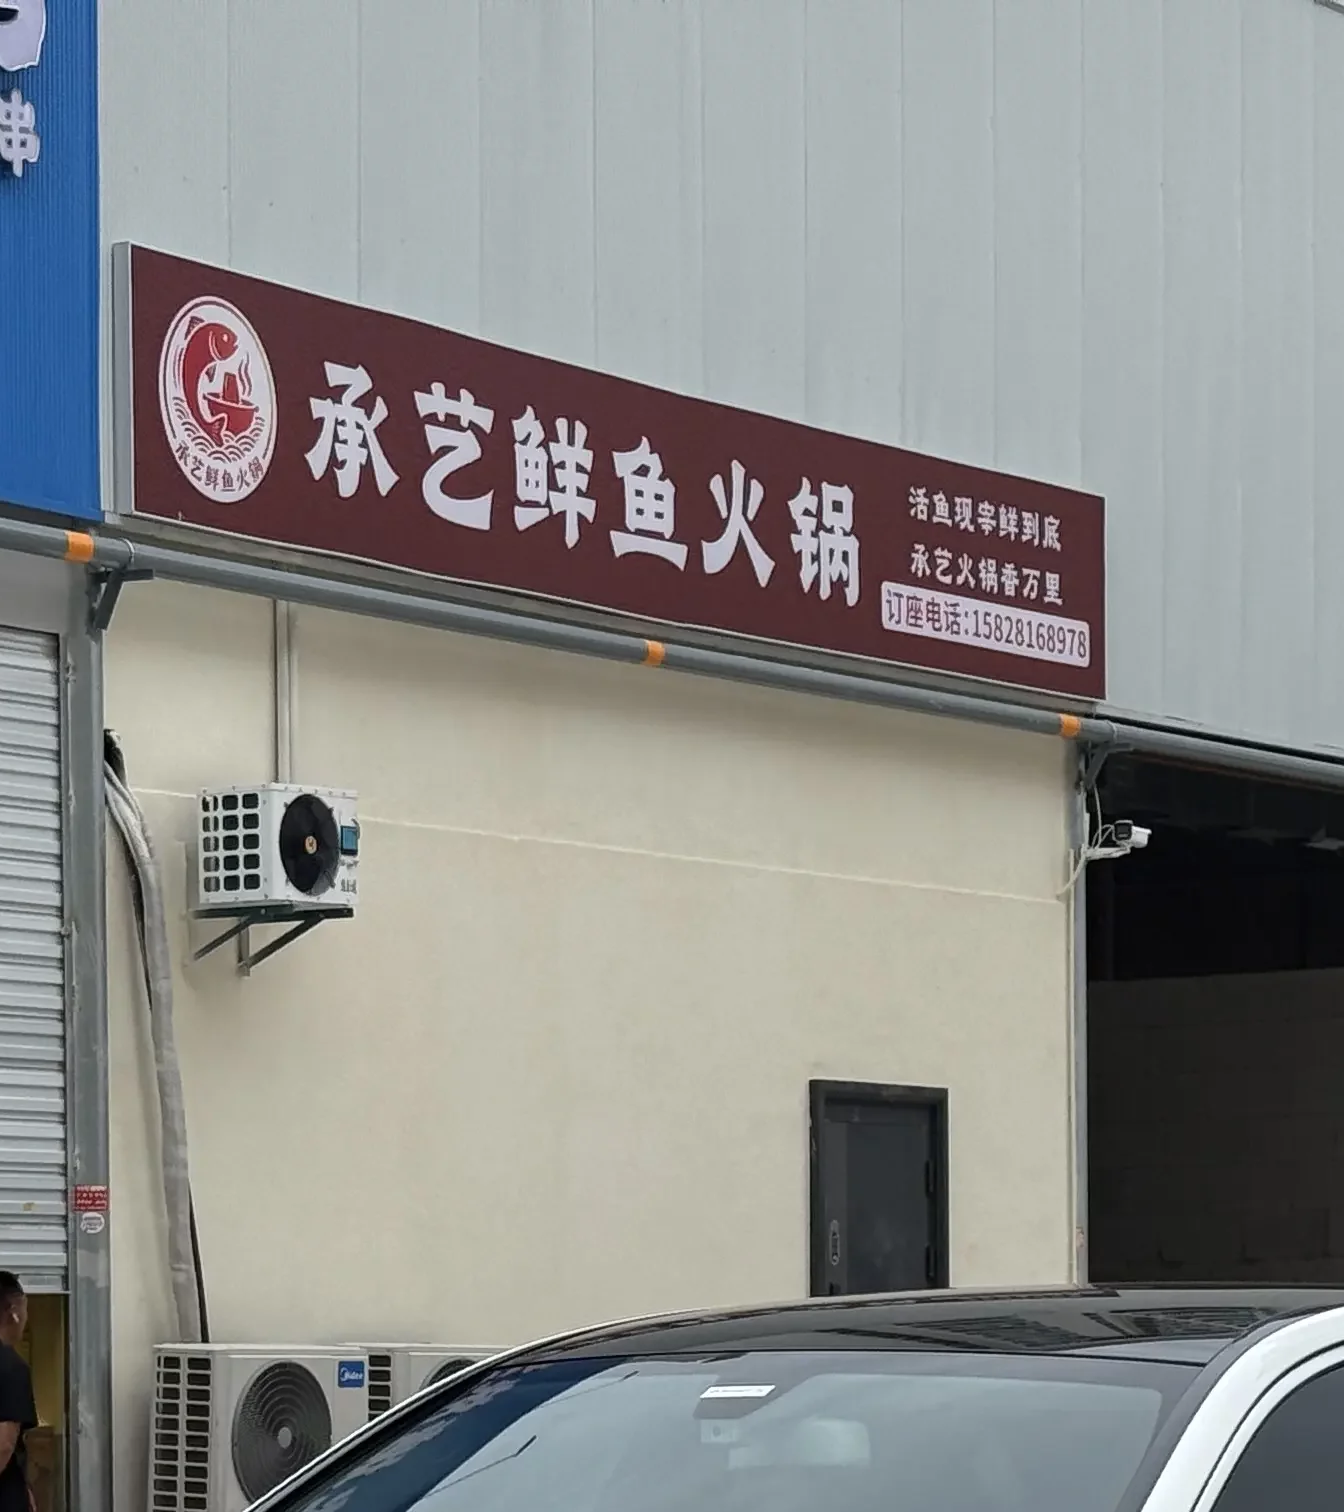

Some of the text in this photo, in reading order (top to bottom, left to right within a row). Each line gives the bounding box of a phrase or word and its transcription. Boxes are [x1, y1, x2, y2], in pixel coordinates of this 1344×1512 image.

[175, 440, 264, 492] 承艺鲜鱼火锅
[302, 361, 860, 606] 承艺鲜鱼火锅
[908, 486, 1062, 552] 活鱼现宰鲜到底
[910, 544, 1064, 606] 承艺火锅香万里
